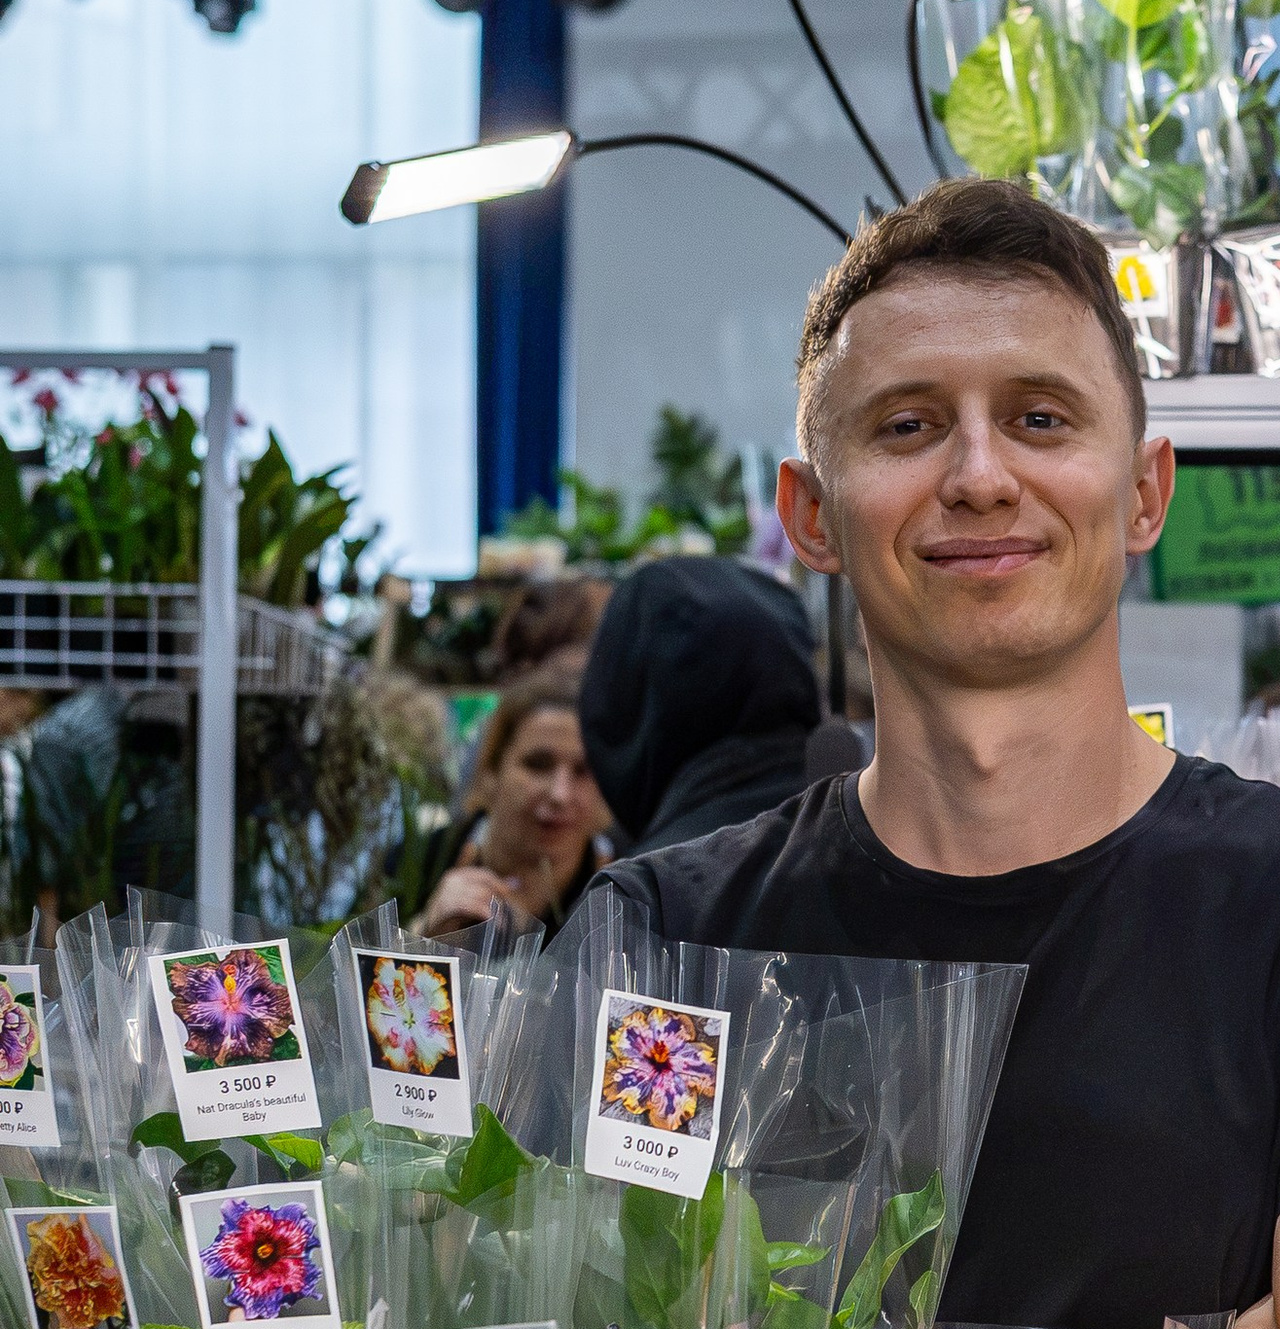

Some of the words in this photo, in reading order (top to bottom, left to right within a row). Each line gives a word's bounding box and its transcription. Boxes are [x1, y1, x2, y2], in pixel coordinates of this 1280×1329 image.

[219, 1080, 229, 1093] 3
[234, 1077, 261, 1092] 500
[265, 1075, 276, 1088] ₽
[394, 1084, 402, 1097] 2
[405, 1085, 425, 1101] 900
[197, 1105, 215, 1114] Nat
[263, 1093, 306, 1107] beautiful
[242, 1112, 266, 1122] Baby
[623, 1135, 633, 1149] 3
[636, 1139, 663, 1156] 000
[667, 1146, 679, 1159] ₽
[615, 1156, 631, 1168] Luv
[634, 1161, 660, 1177] Crazy
